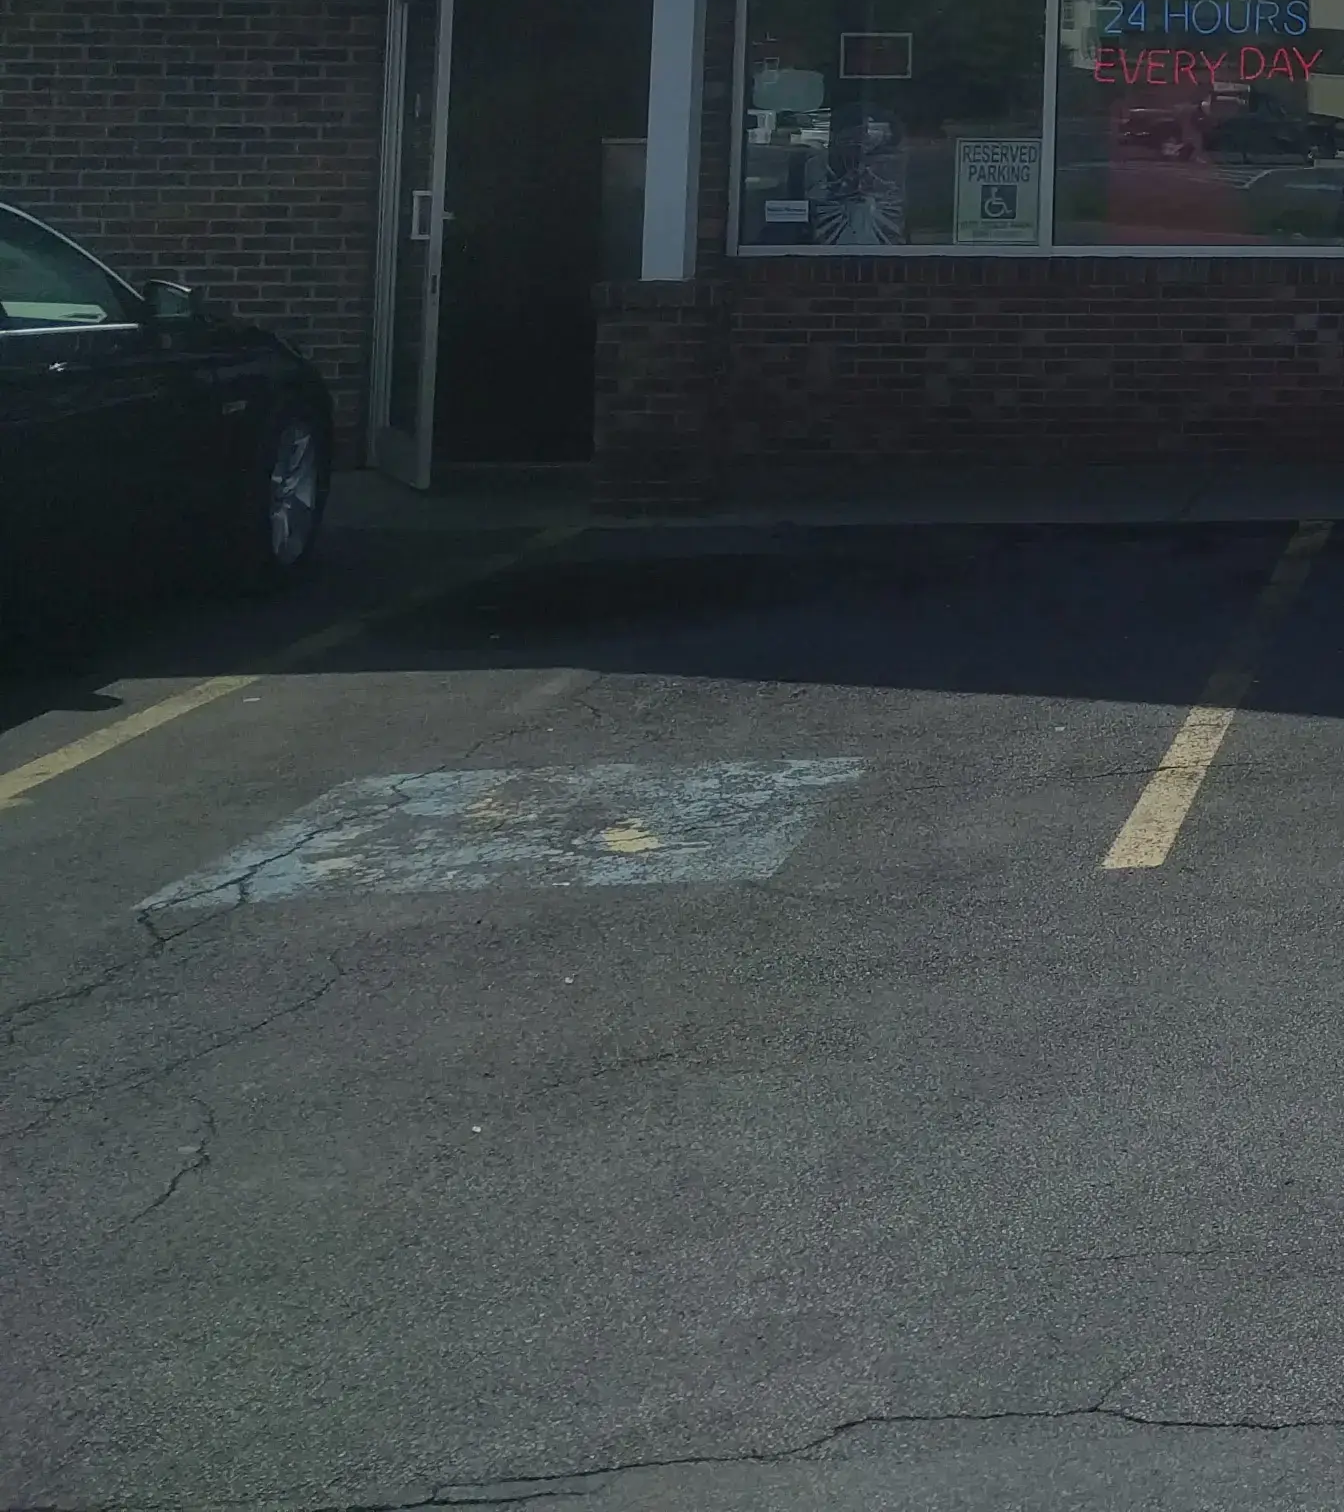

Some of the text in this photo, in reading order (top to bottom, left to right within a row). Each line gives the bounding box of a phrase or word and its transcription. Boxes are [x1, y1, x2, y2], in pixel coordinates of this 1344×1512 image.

[1103, 0, 1309, 36] 24 HOURS
[1093, 45, 1324, 85] EVERY DAY
[962, 144, 1038, 163] RESERVED
[967, 165, 1031, 182] PARKING
